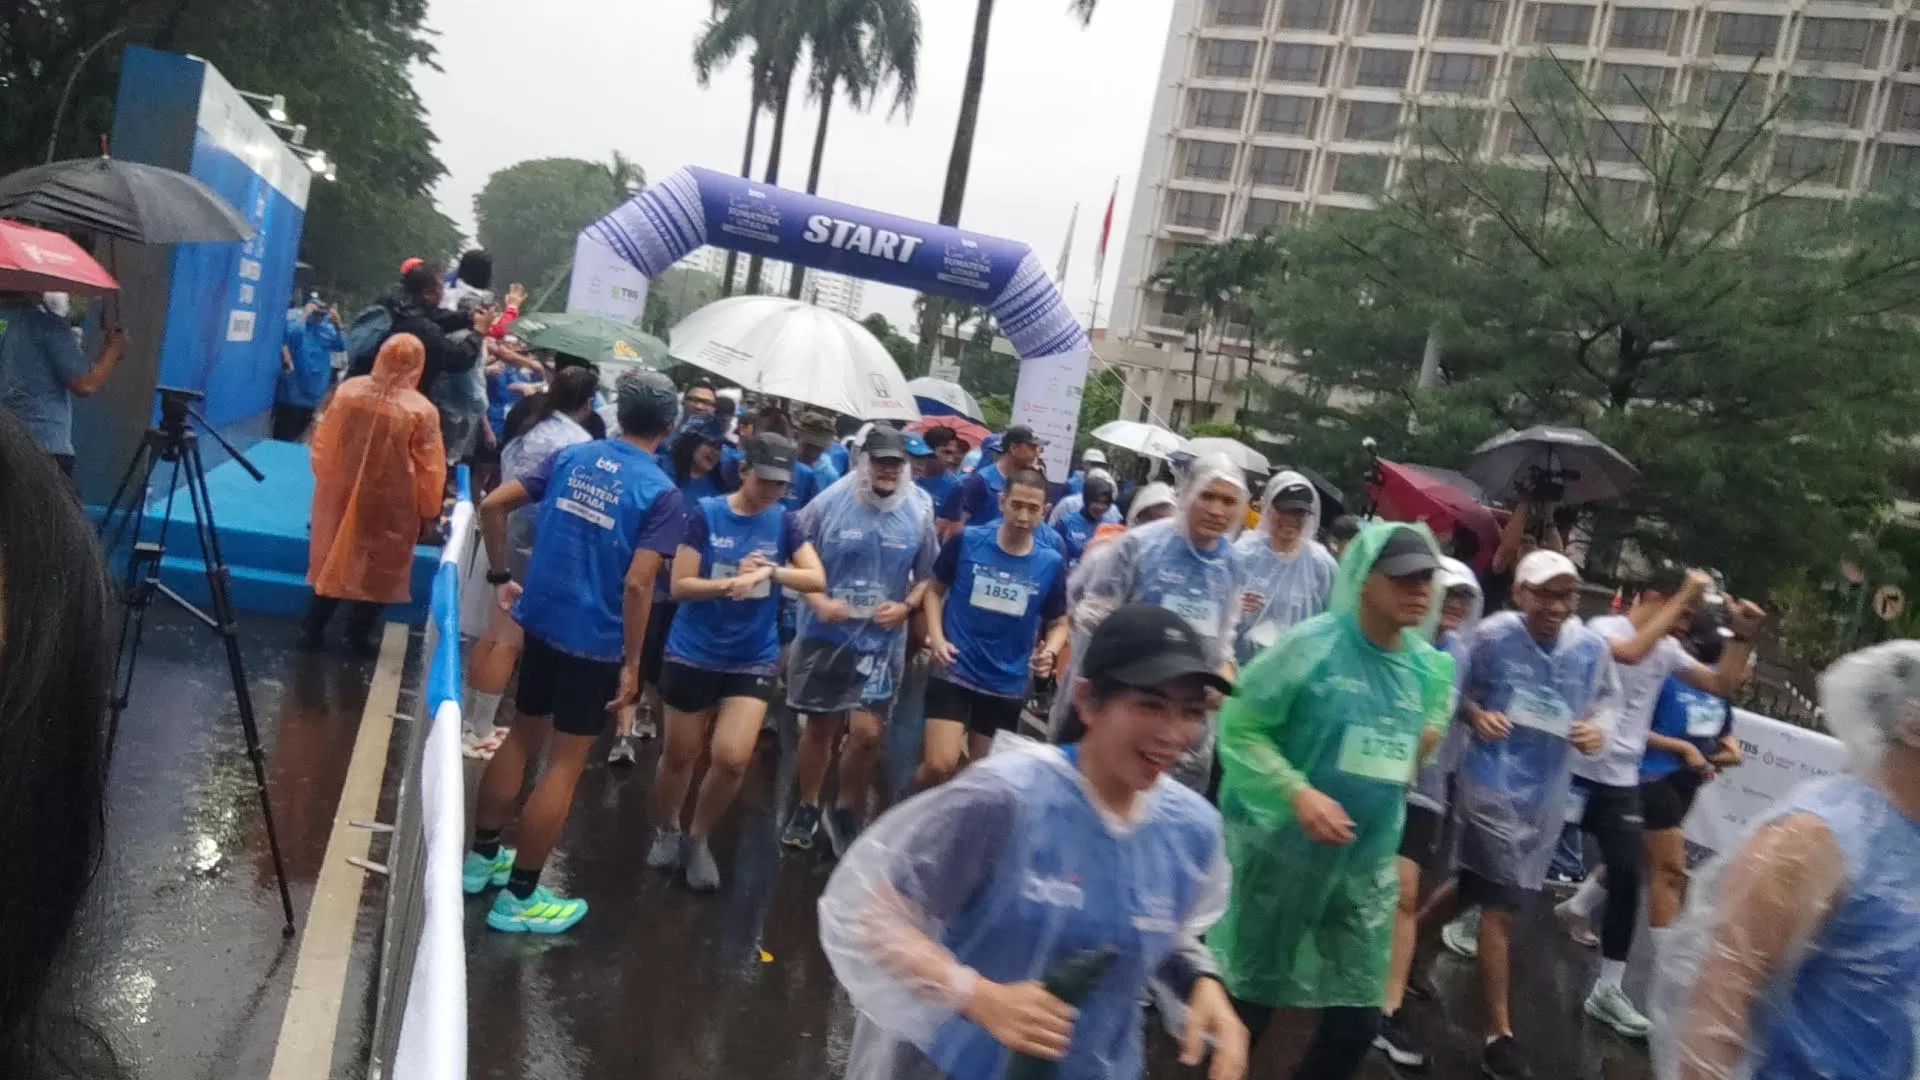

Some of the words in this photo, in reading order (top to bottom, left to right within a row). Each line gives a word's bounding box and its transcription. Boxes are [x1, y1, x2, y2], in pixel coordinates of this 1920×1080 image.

[803, 214, 925, 264] START
[567, 476, 620, 505] SUMATERA
[572, 489, 606, 512] UTARA
[983, 584, 1019, 602] 1852
